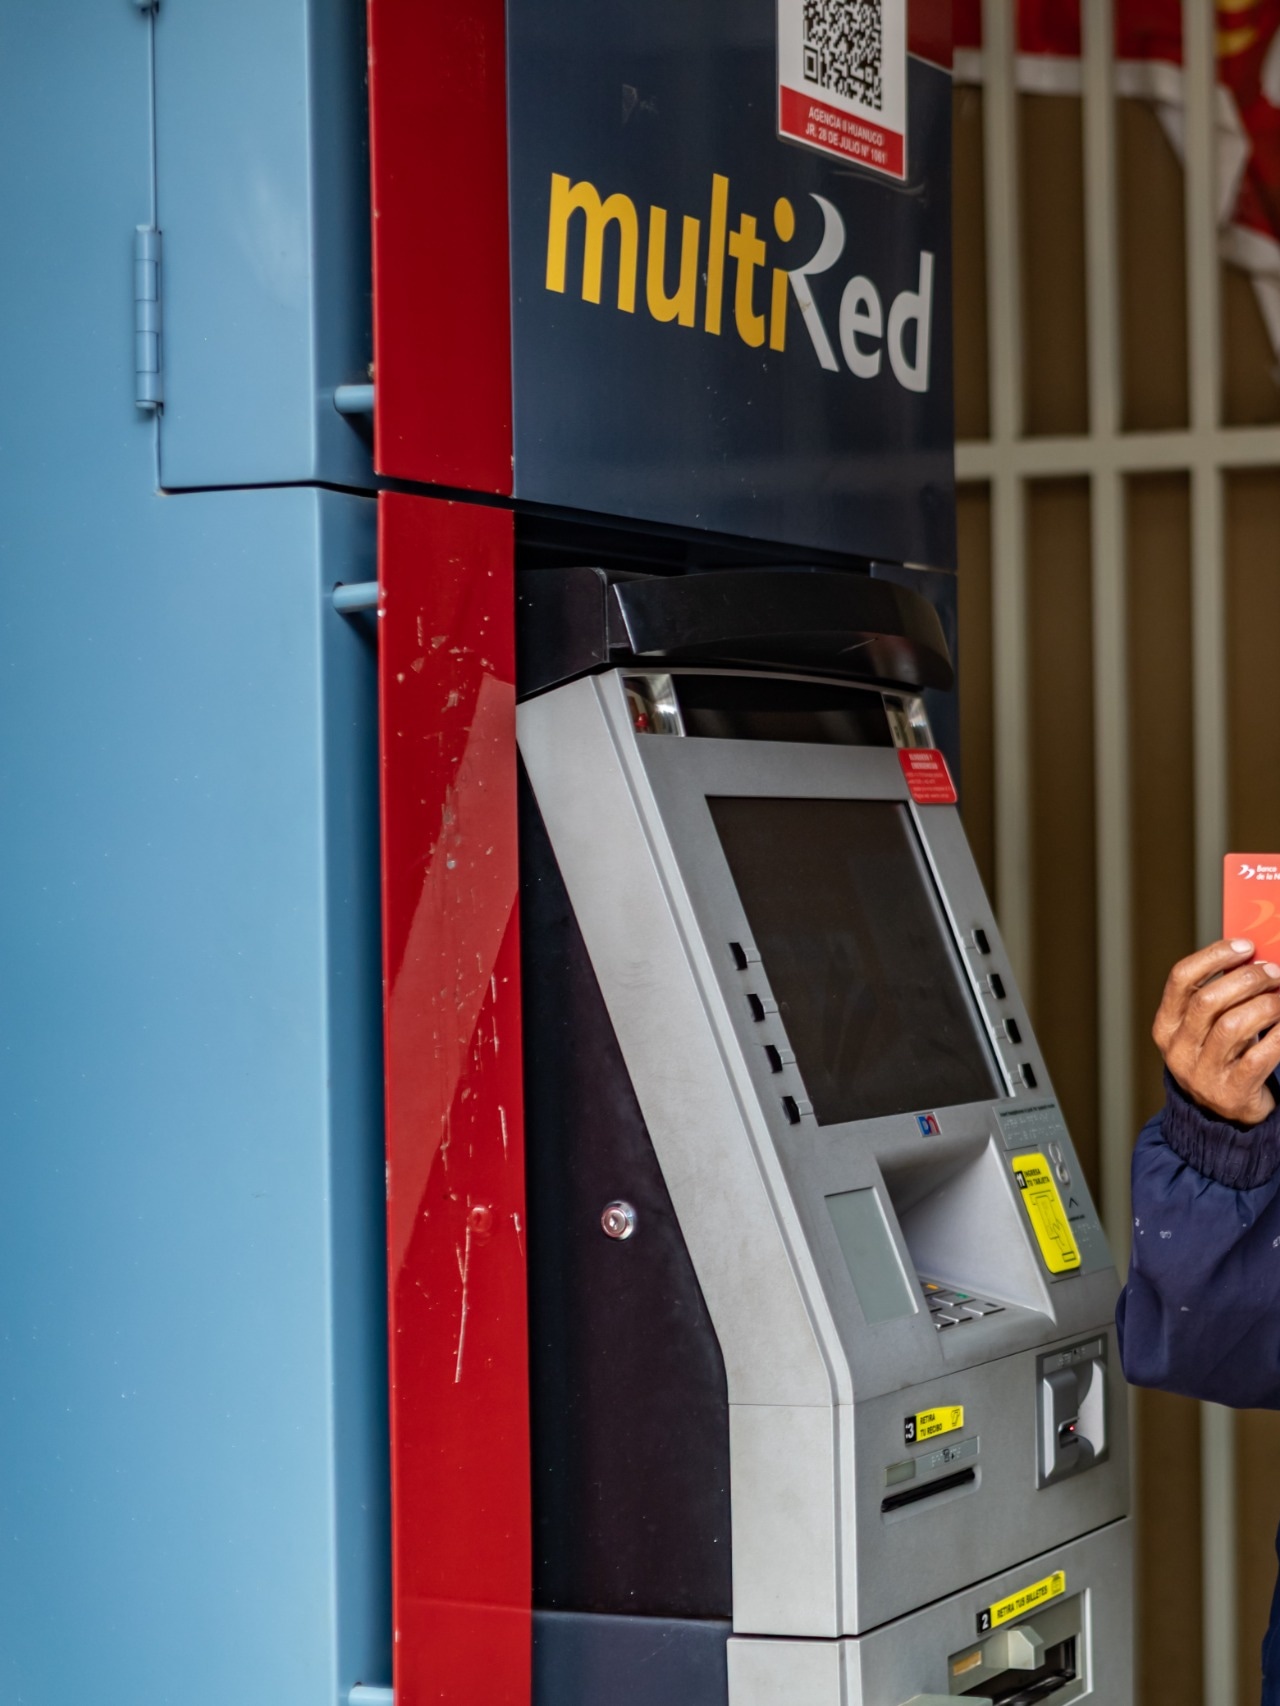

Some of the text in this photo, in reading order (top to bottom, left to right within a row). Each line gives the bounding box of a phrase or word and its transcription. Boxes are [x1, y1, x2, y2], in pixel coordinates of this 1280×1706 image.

[808, 106, 841, 130] AGENCIA
[828, 130, 840, 145] DE
[840, 135, 860, 154] JULIO
[545, 172, 935, 393] multiRed
[1256, 864, 1277, 873] Banco
[1256, 873, 1265, 881] de
[905, 1413, 936, 1439] 3 RETIRA
[920, 1423, 943, 1437] TU RECIBO
[981, 1613, 990, 1630] 2
[997, 1604, 1015, 1619] RETIRA
[1026, 1585, 1048, 1603] BILLETES
